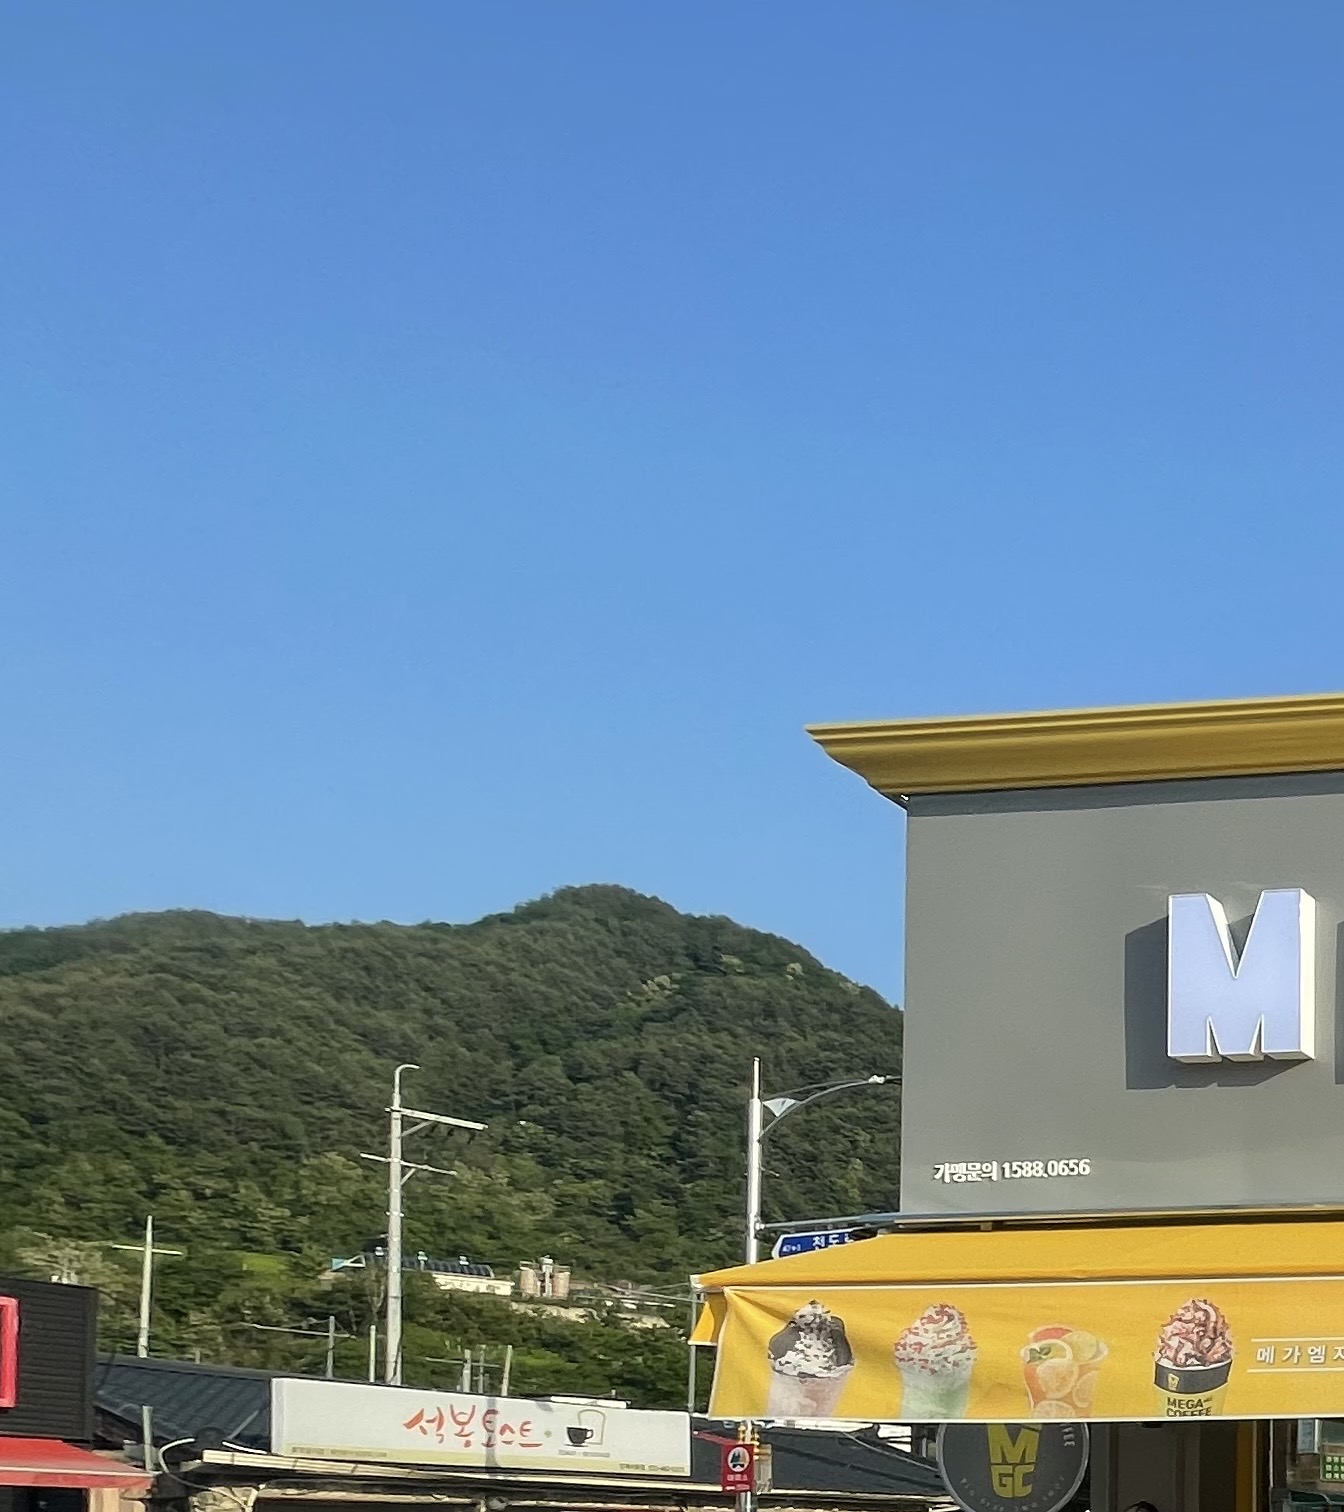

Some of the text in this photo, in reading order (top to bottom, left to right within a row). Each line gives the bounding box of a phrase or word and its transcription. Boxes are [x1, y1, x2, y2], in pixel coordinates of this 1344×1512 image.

[934, 1159, 1091, 1183] 가맹문의 1588.0656
[1167, 1397, 1204, 1409] MEGA
[403, 1404, 543, 1448] 석봉토스트
